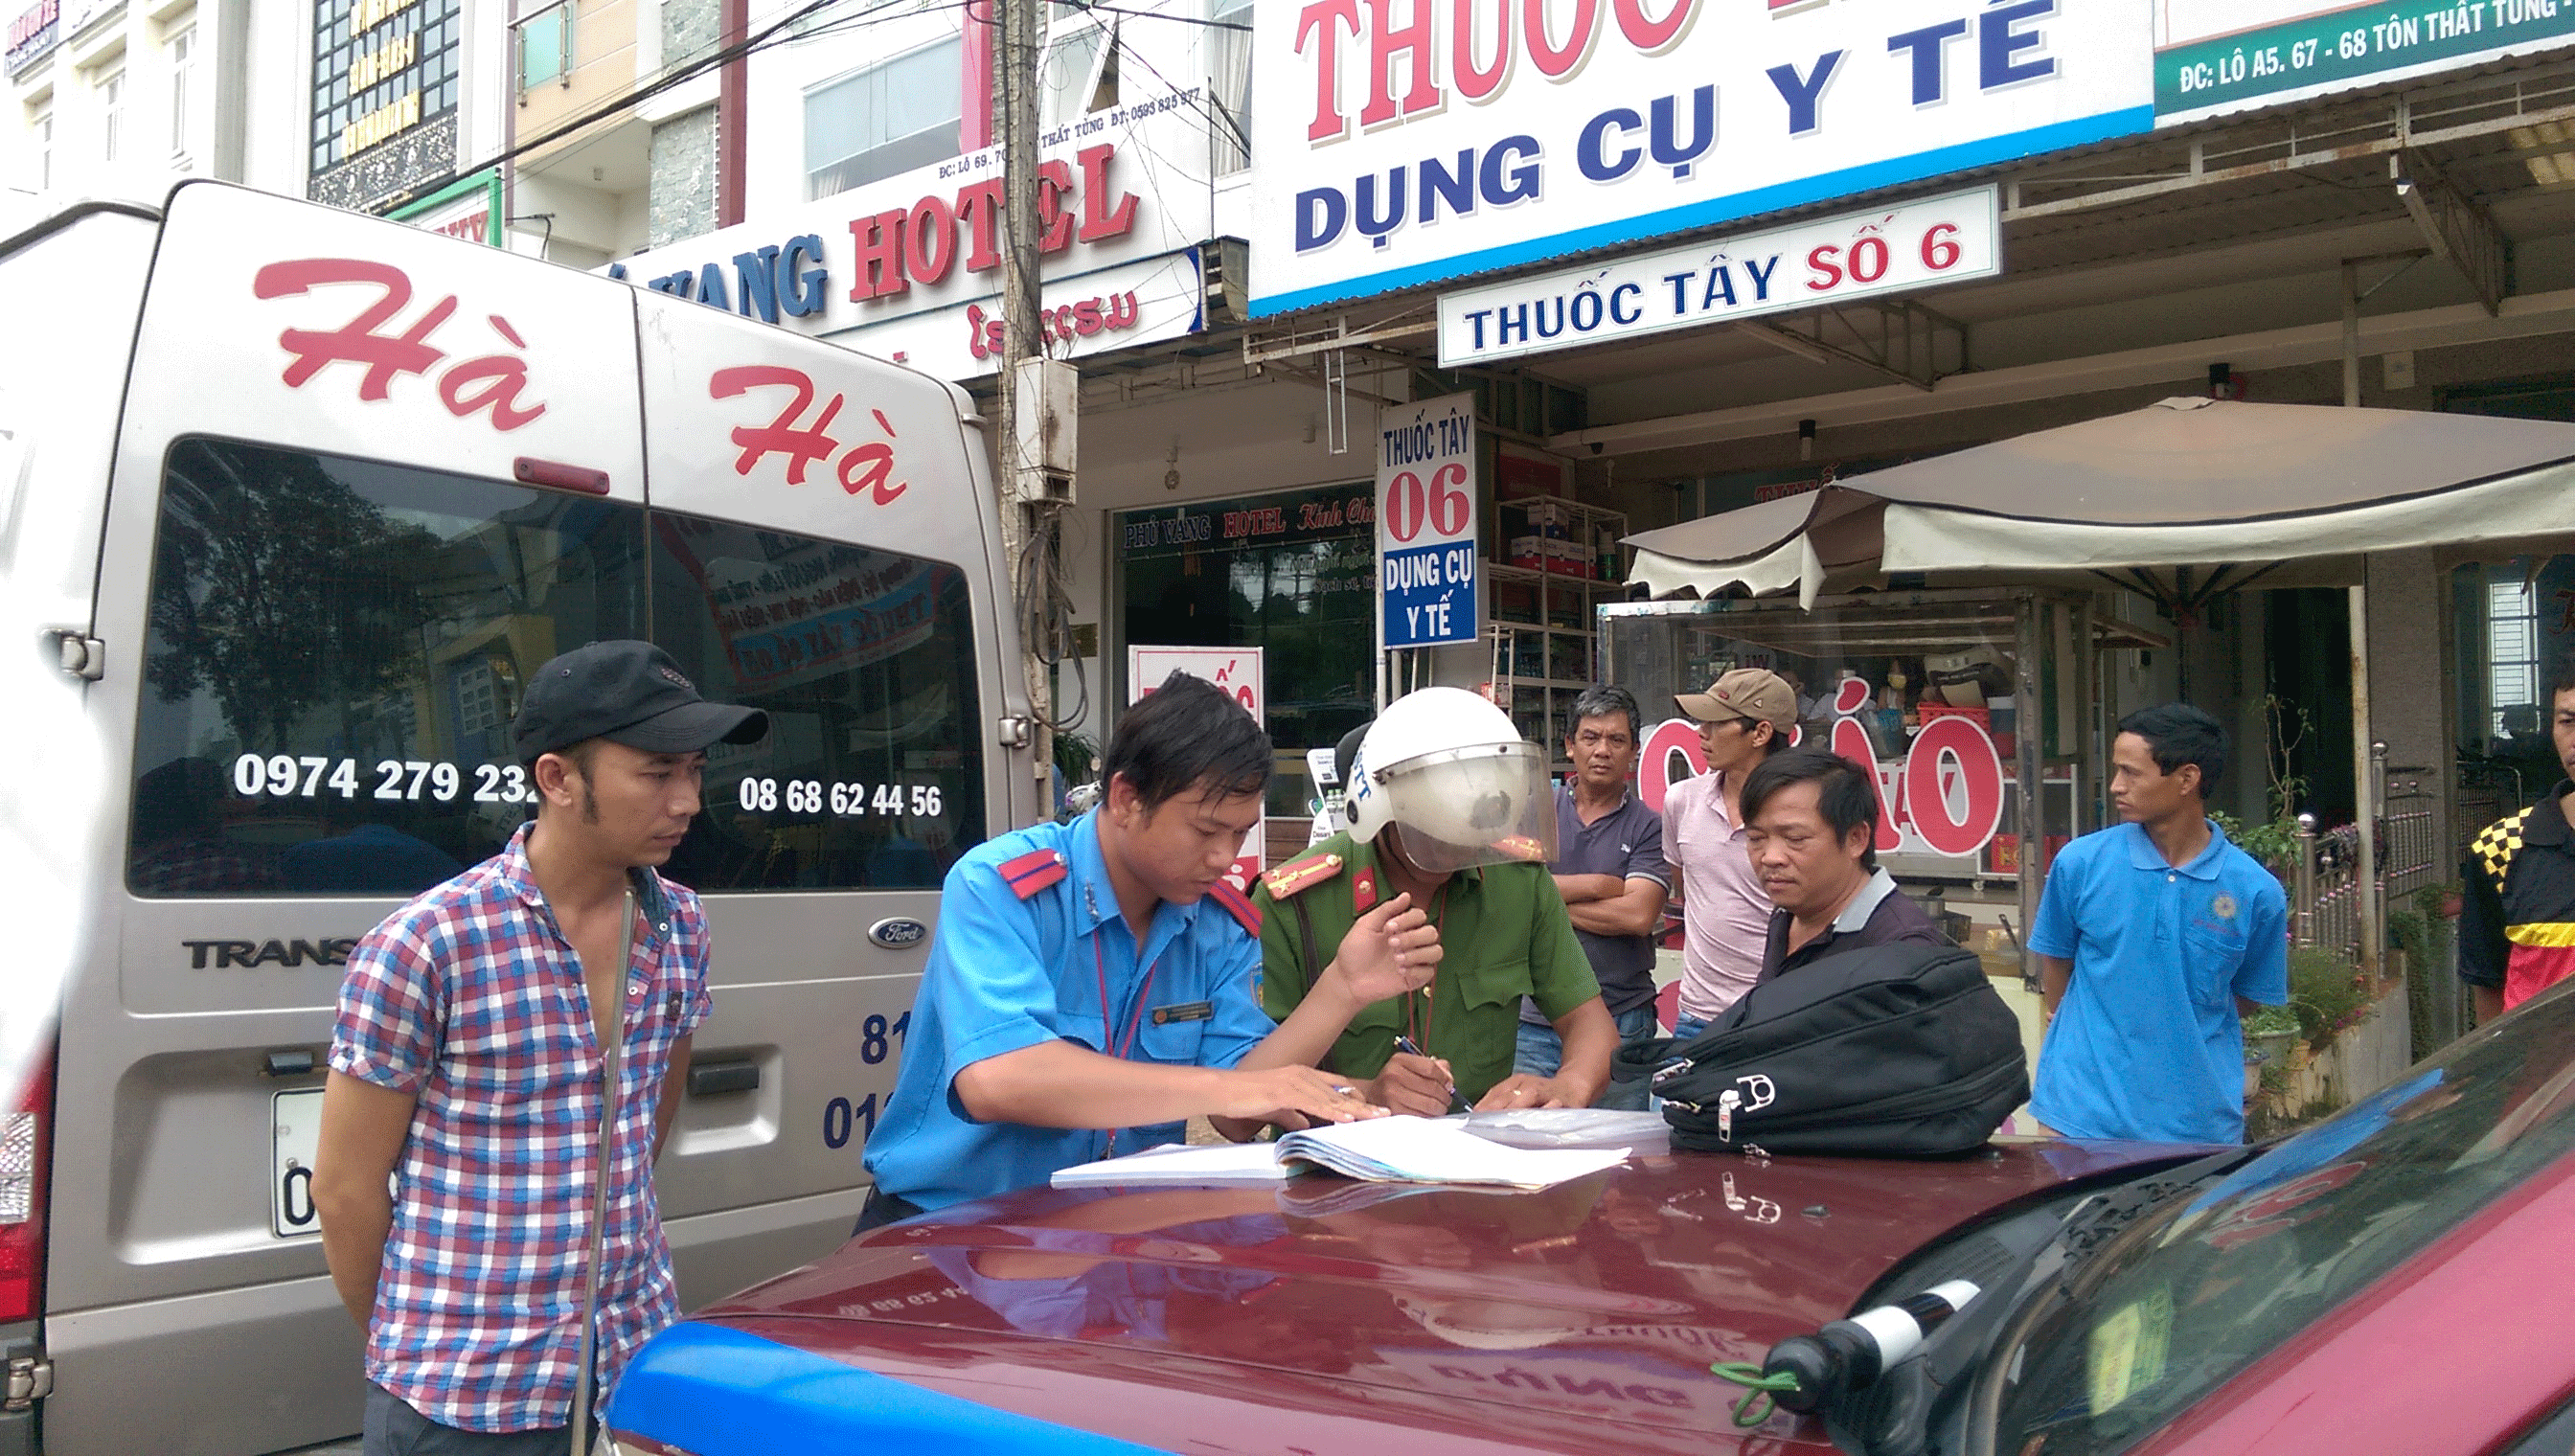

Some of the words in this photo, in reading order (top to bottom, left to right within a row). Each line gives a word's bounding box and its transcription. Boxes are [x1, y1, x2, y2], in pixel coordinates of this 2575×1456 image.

[2180, 65, 2213, 93] ĐC:
[2220, 48, 2245, 84] LÔ
[2252, 46, 2285, 79] A5.
[2292, 38, 2317, 68] 67
[2339, 25, 2366, 59] 68
[2373, 13, 2418, 52] TÔN
[1158, 95, 1179, 113] 825
[1295, 134, 1544, 253] DỤNG
[1576, 83, 1717, 180] CỤ
[1766, 49, 1845, 135] Y
[849, 143, 1140, 303] HOTEL
[1463, 269, 1644, 352] THUỐC
[1662, 253, 1782, 316] TÂY
[1804, 212, 1899, 291] SỐ
[1920, 222, 1962, 270] 6
[253, 258, 546, 432] Hà
[709, 365, 907, 507] Hà
[1383, 408, 1435, 467] THUỐC
[1439, 407, 1470, 457] TÂY
[1223, 506, 1287, 539] HOTEL
[1385, 463, 1470, 543] 06
[1385, 552, 1440, 596] DỤNG
[1445, 548, 1472, 589] CỤ
[1406, 606, 1420, 639] Y
[1425, 588, 1454, 637] TẾ
[234, 754, 358, 798] 0974
[375, 759, 460, 802] 279
[473, 764, 537, 804] 23
[739, 777, 778, 811] 08
[786, 779, 824, 814] 68
[830, 781, 864, 815] 62
[871, 783, 904, 816] 44
[911, 785, 943, 818] 56
[885, 922, 920, 942] Ford
[823, 1091, 895, 1149] 01
